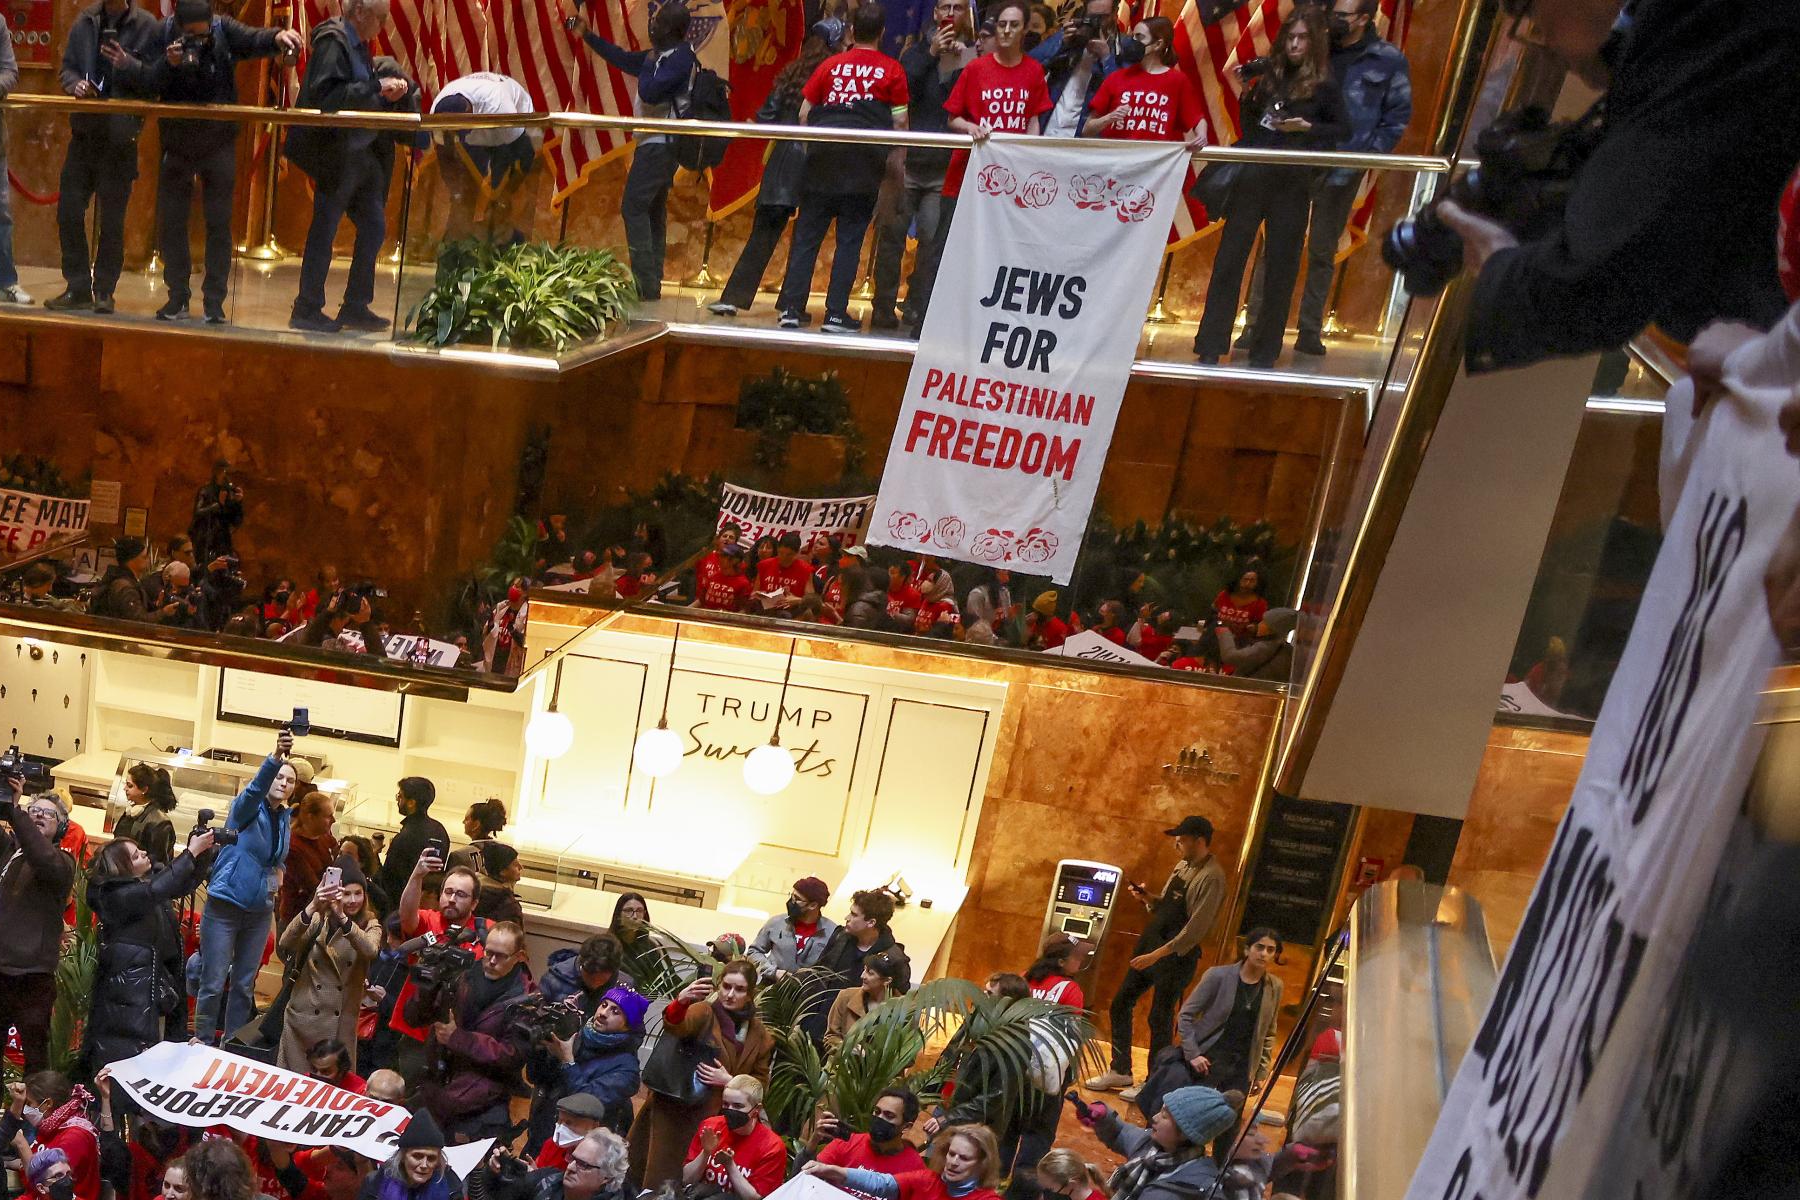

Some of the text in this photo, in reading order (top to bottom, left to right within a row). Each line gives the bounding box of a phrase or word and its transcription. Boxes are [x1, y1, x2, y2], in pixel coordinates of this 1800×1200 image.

[830, 64, 884, 79] JEWS
[833, 78, 875, 92] SAY
[982, 89, 1014, 100] NOT
[988, 102, 1026, 115] OUR
[1120, 91, 1169, 105] STOP
[980, 266, 1087, 320] JEWS
[981, 322, 1058, 373] FOR
[921, 368, 1096, 426] PALESTINIAN
[904, 409, 1082, 482] FREEDOM
[696, 692, 833, 729] TRUMP
[1092, 869, 1118, 883] ATM
[125, 1077, 261, 1121] DEPORT
[188, 1058, 395, 1118] MOVEMENT
[260, 1109, 377, 1142] CAN'T
